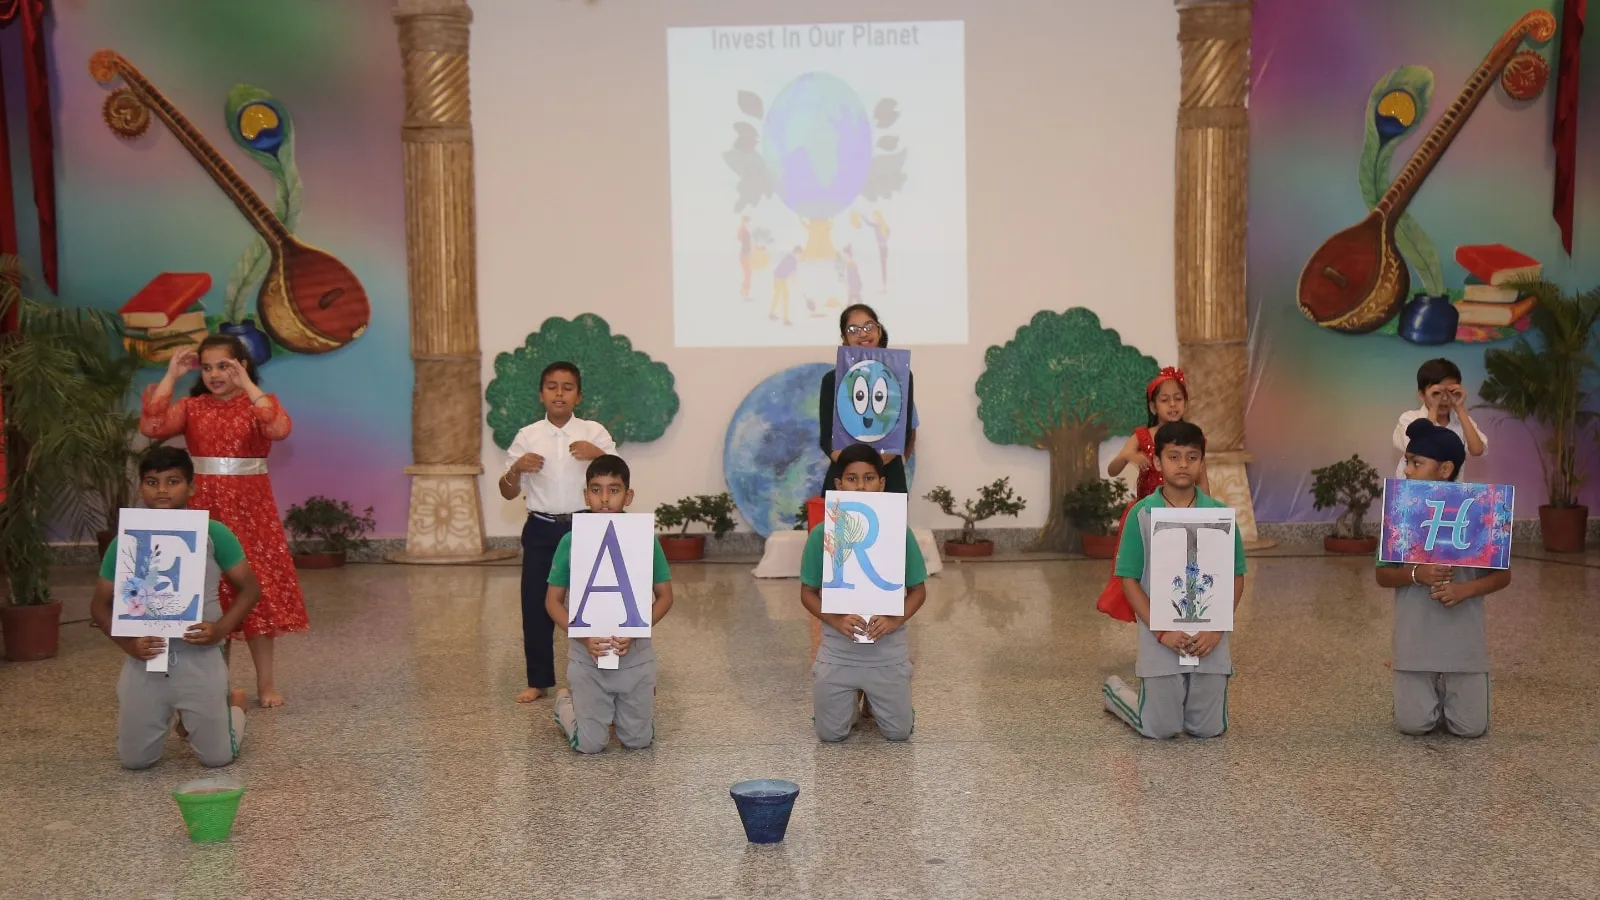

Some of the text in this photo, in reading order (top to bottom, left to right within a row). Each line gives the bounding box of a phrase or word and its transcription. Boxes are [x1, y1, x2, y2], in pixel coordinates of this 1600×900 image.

[711, 23, 919, 50] Invest In Our Planet
[823, 501, 903, 591] R
[1420, 498, 1475, 551] H
[118, 529, 200, 621] E
[568, 519, 649, 627] A
[1153, 521, 1232, 623] T
